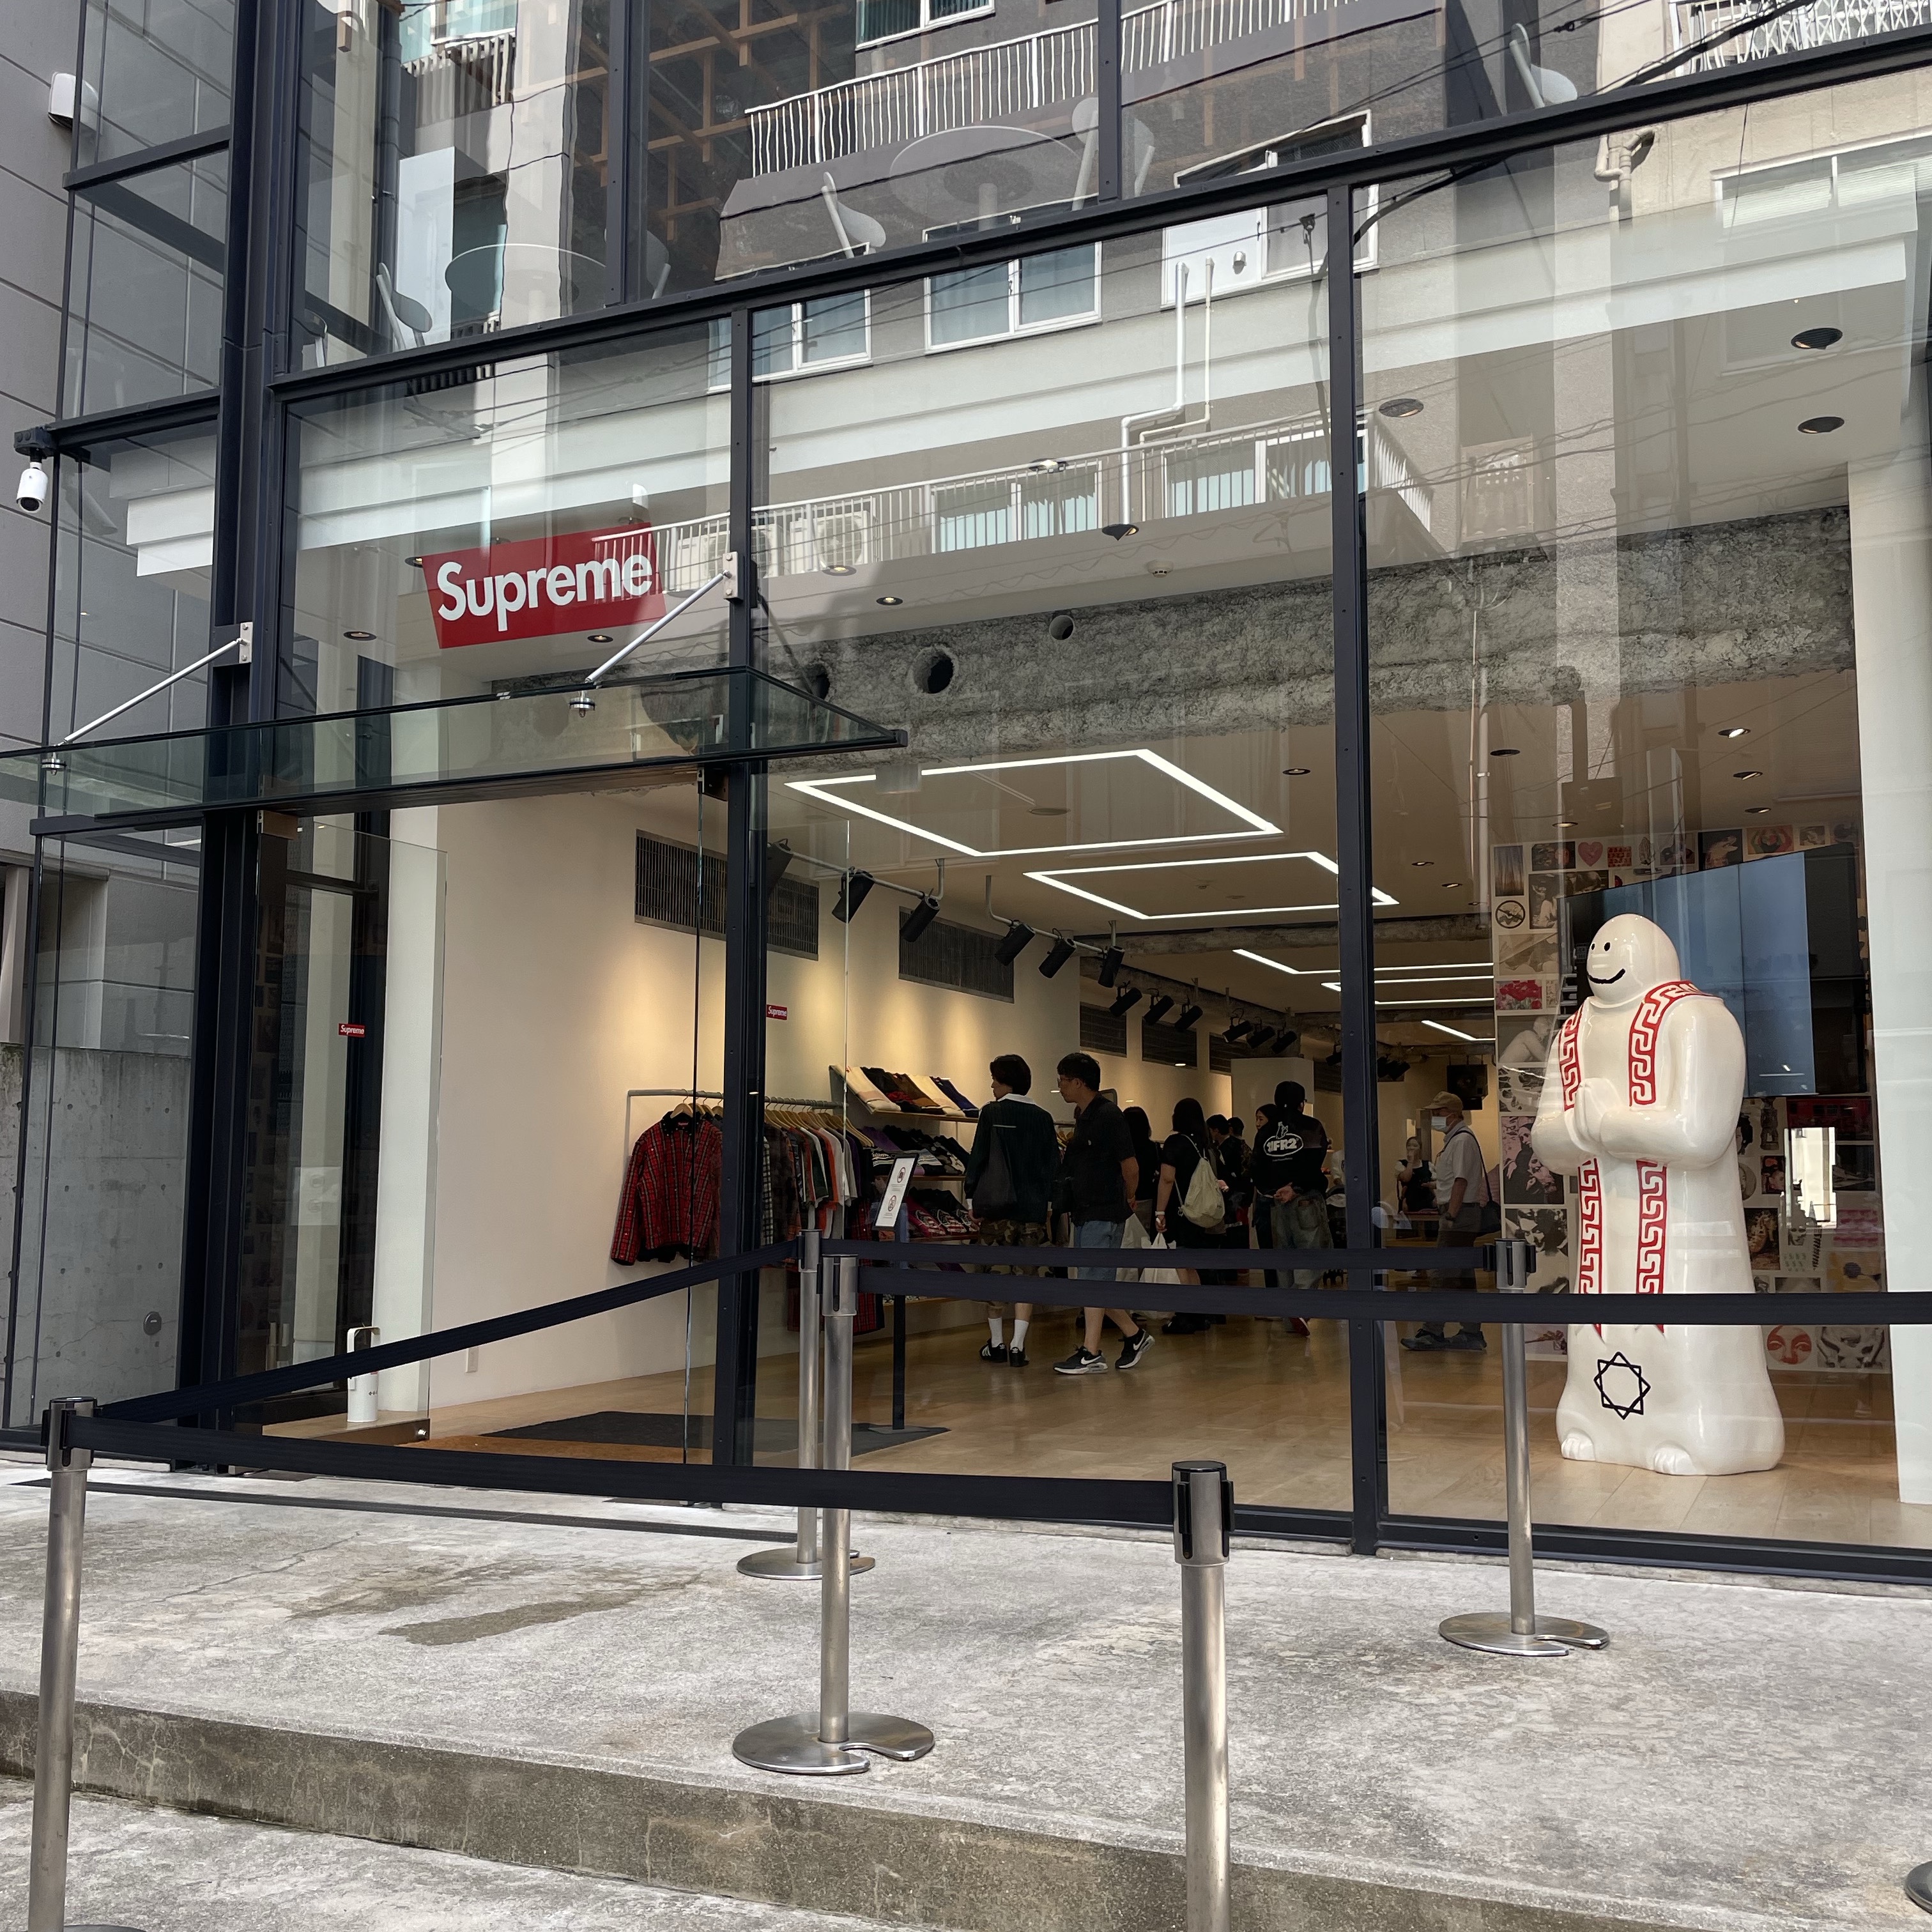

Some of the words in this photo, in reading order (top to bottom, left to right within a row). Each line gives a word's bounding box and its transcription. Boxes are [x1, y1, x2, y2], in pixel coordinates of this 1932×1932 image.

[437, 554, 652, 632] Supreme
[768, 1006, 787, 1017] Supreme
[340, 1024, 365, 1035] Supreme
